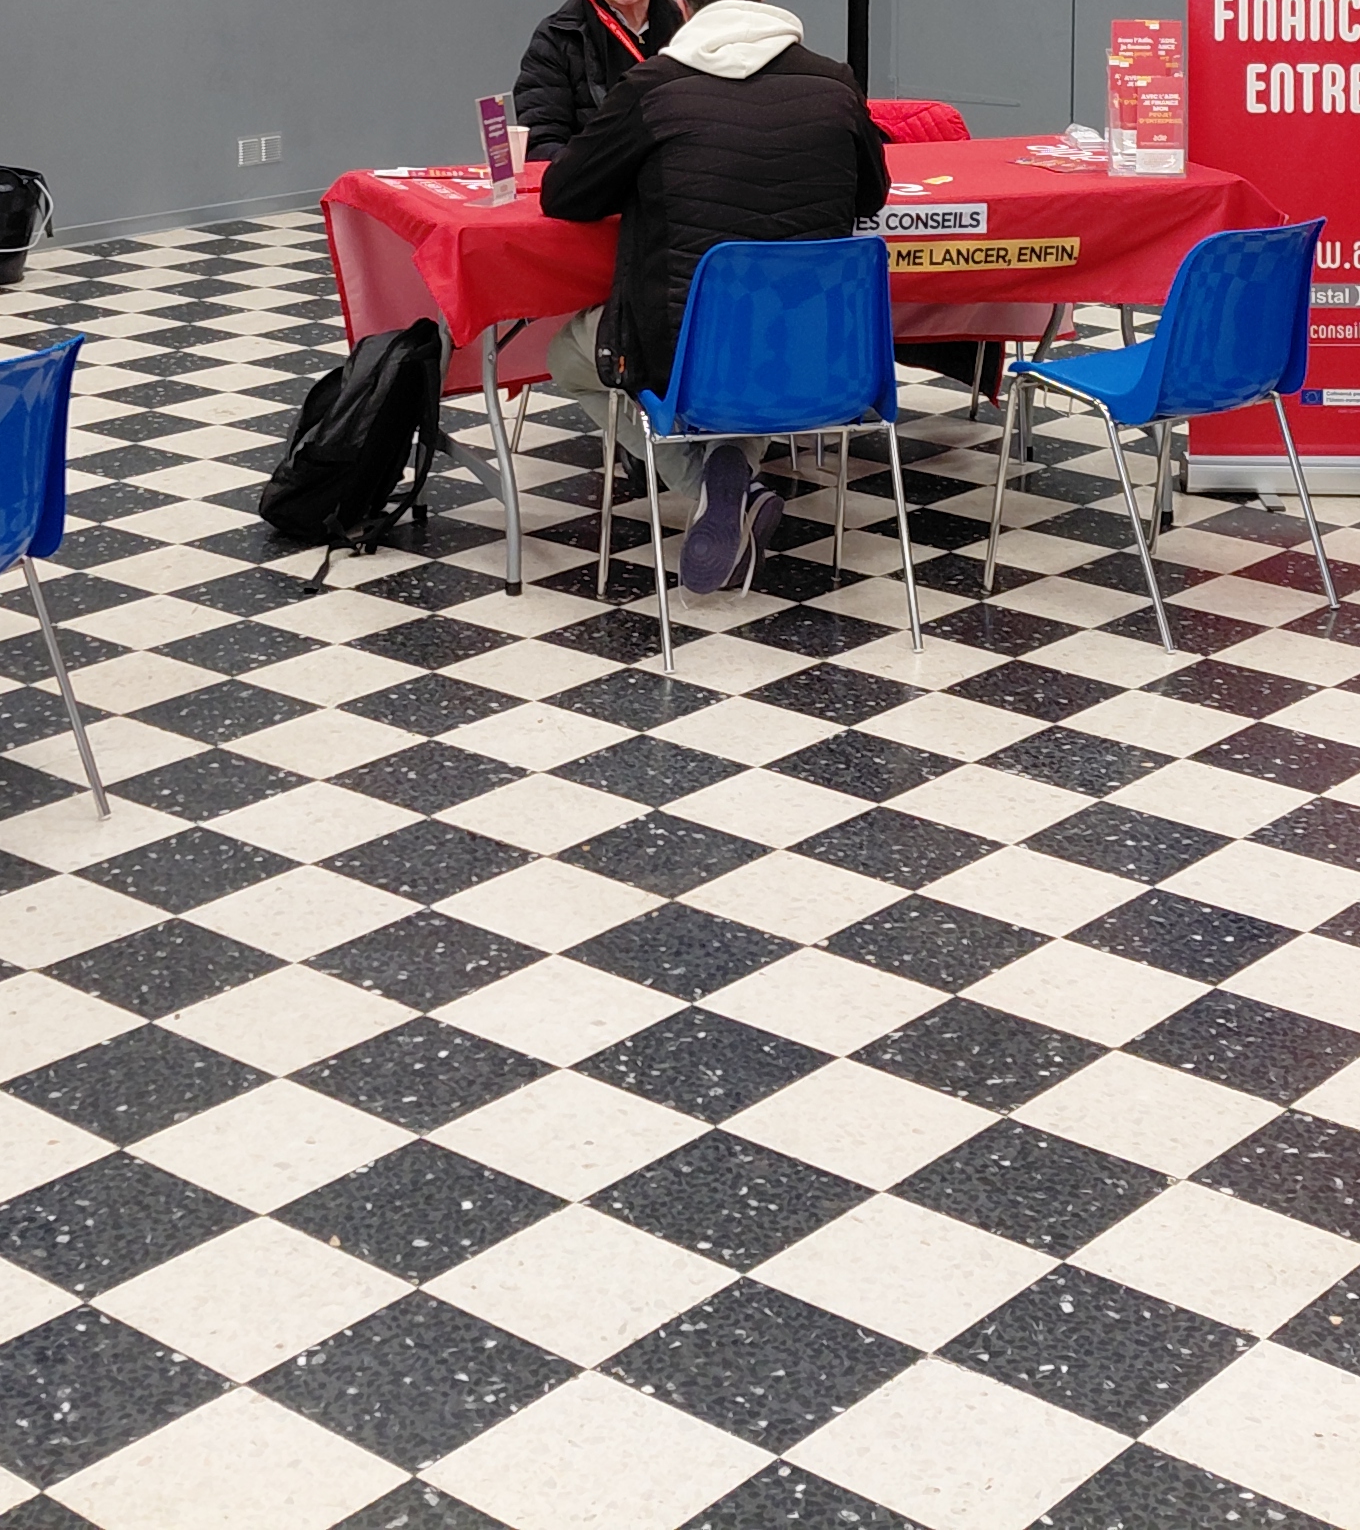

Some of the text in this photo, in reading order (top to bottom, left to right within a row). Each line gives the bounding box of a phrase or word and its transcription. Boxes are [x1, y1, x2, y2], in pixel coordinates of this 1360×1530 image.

[854, 211, 981, 231] ES CONSEILS
[895, 248, 925, 267] ME
[929, 245, 1012, 267] LANCER,
[1017, 244, 1078, 263] ENFIN.
[1308, 287, 1351, 305] istal
